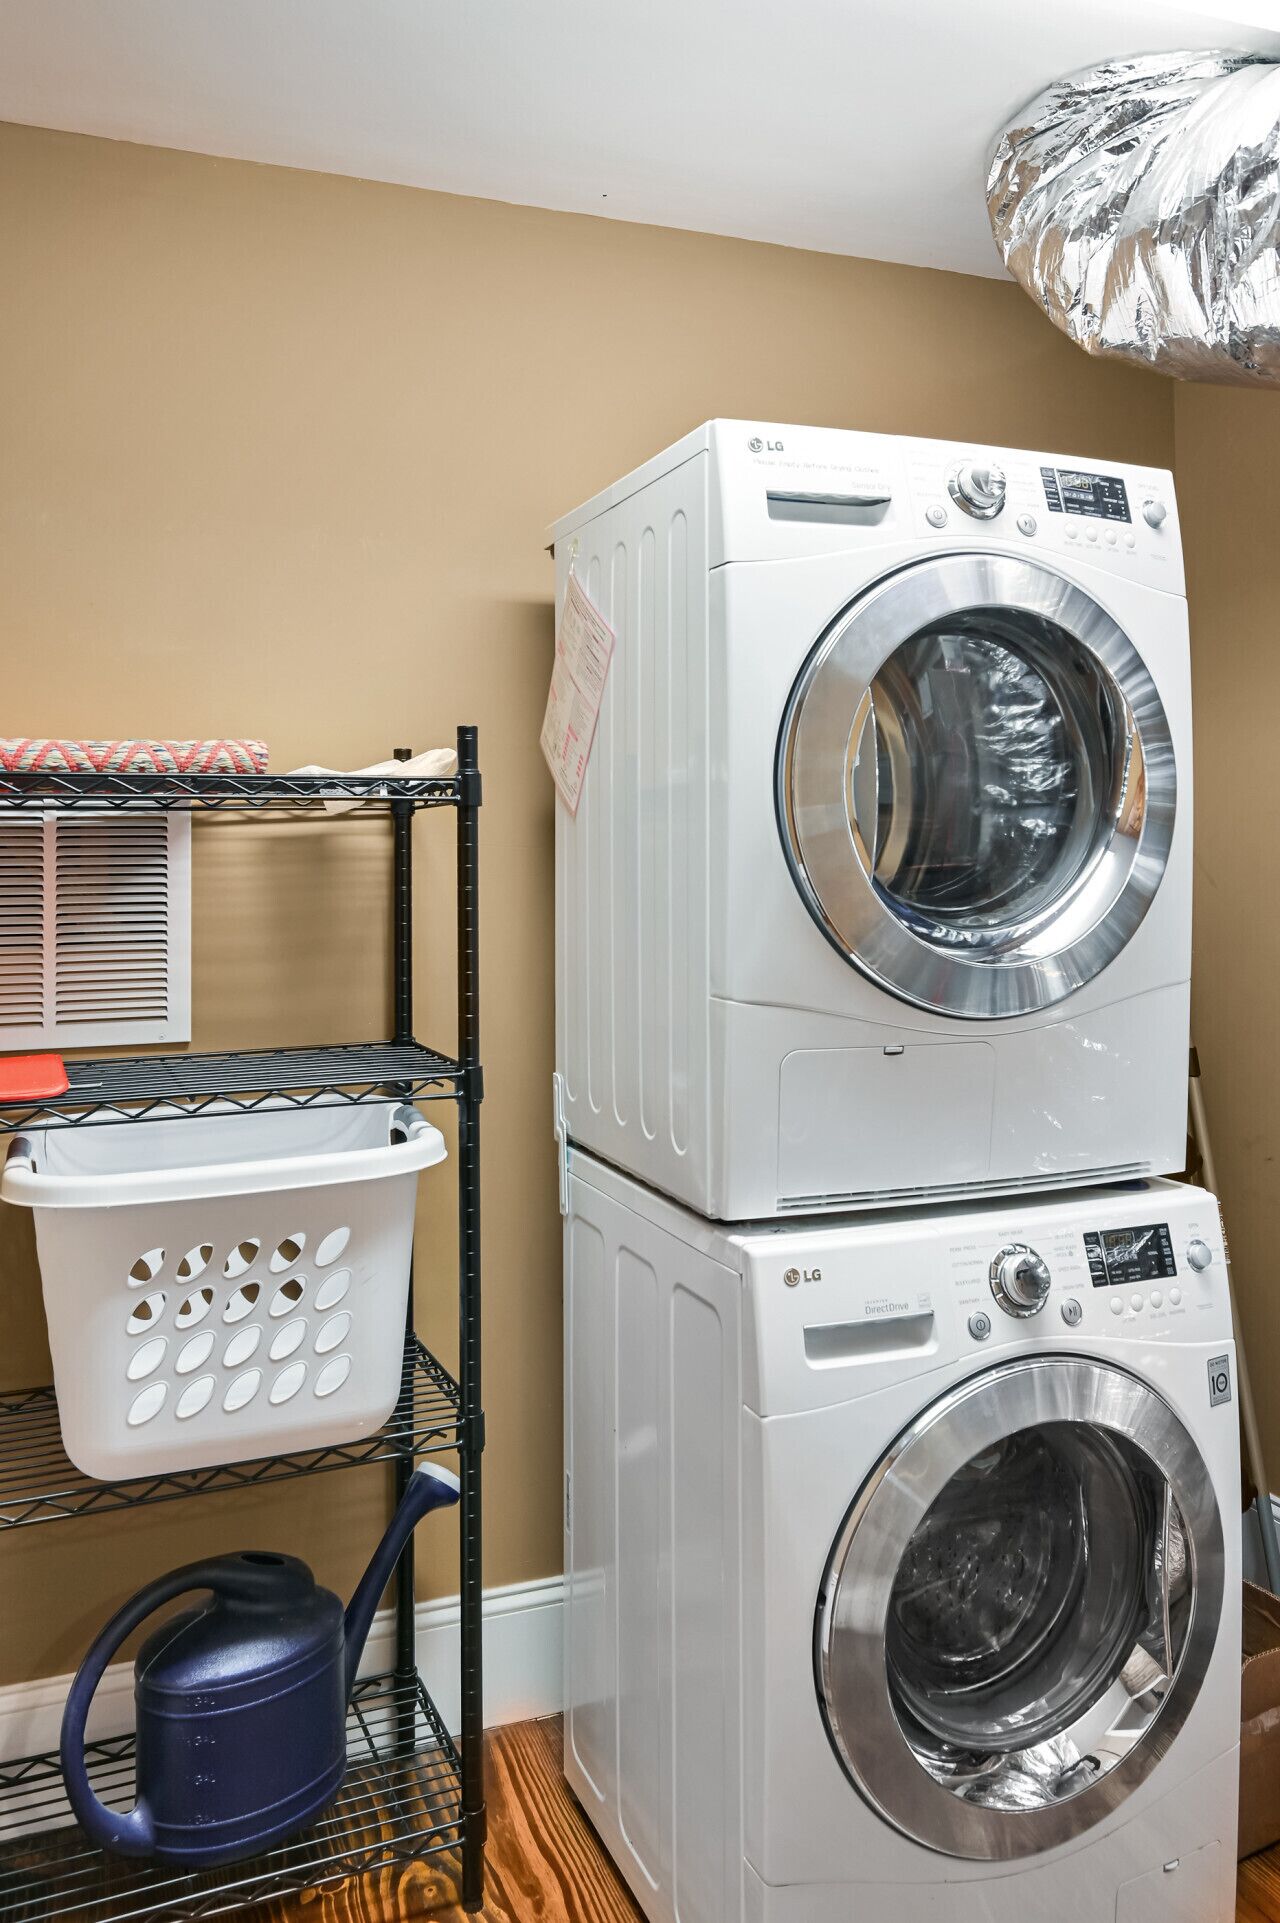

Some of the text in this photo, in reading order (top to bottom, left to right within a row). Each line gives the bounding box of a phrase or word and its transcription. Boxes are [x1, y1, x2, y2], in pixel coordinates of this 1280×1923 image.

[767, 440, 784, 452] LG
[803, 1269, 822, 1282] LG
[865, 1303, 909, 1315] DirectDrive
